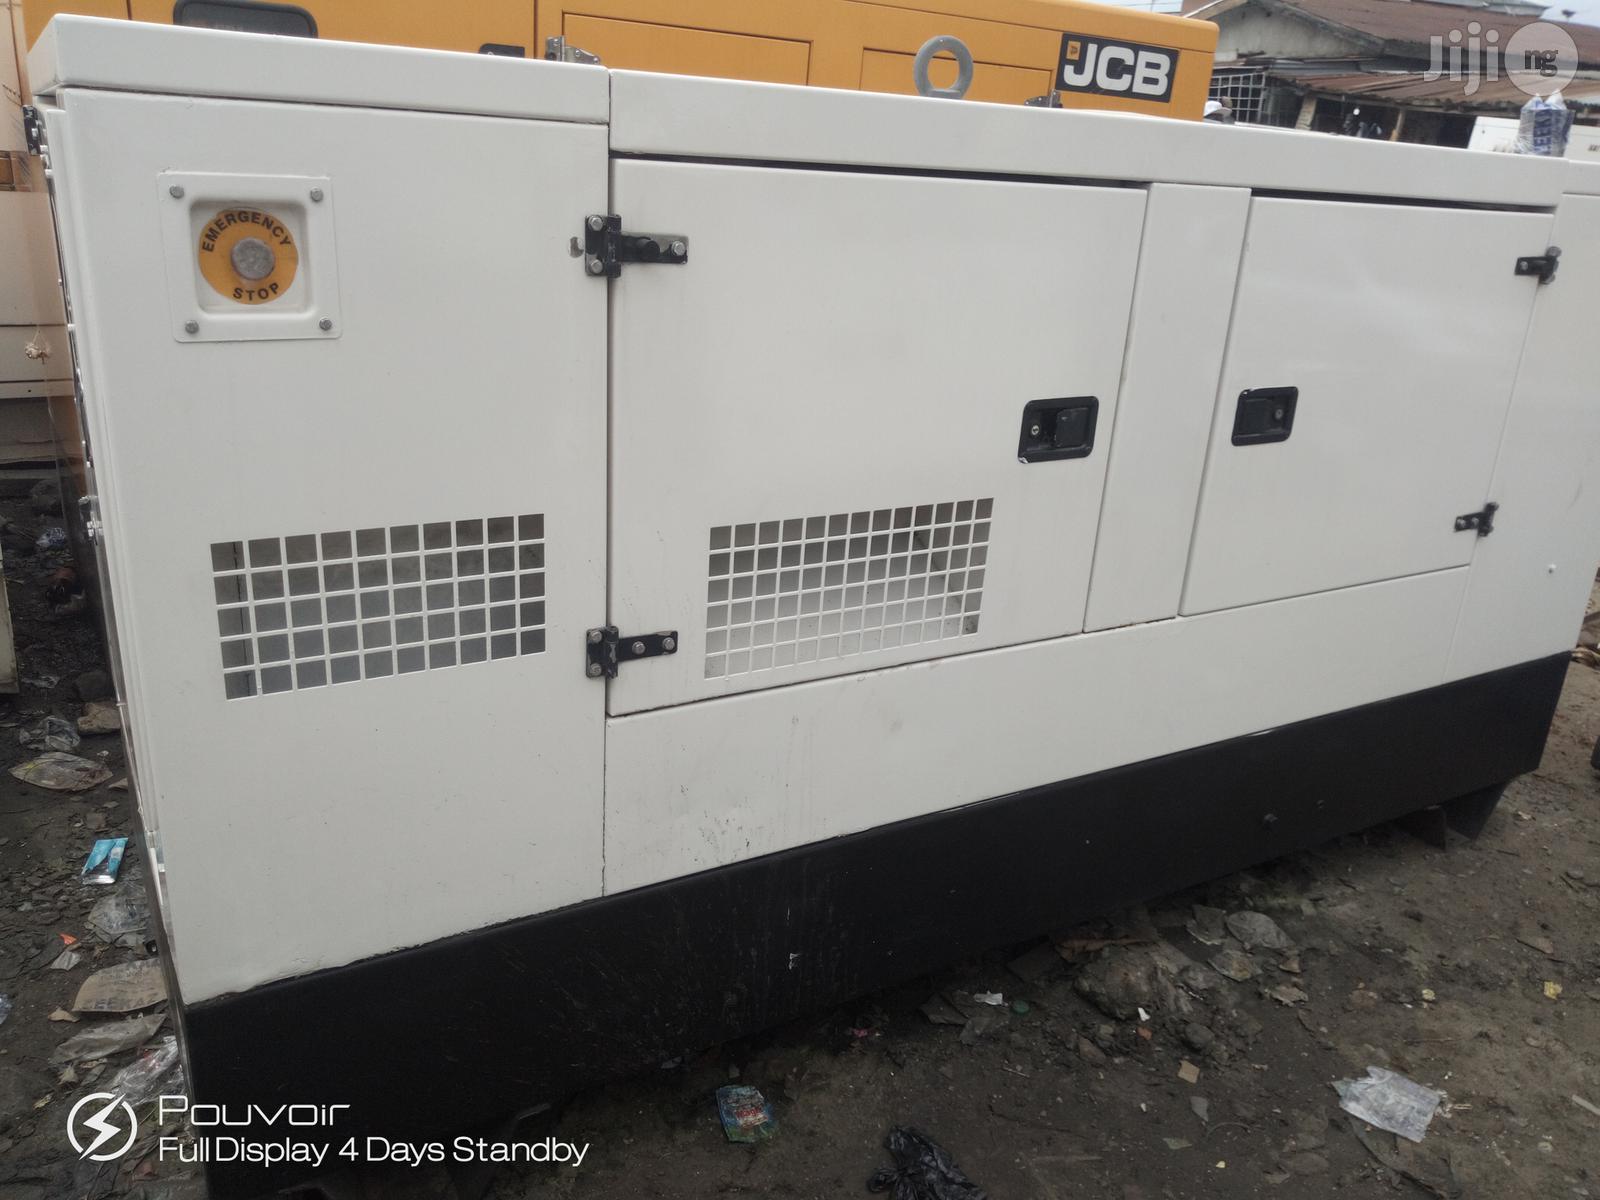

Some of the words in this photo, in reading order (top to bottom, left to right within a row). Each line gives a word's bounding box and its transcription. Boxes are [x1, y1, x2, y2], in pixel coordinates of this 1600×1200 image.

[1063, 43, 1171, 96] JCB
[202, 210, 292, 252] EMERGENCY
[232, 282, 280, 301] STOP
